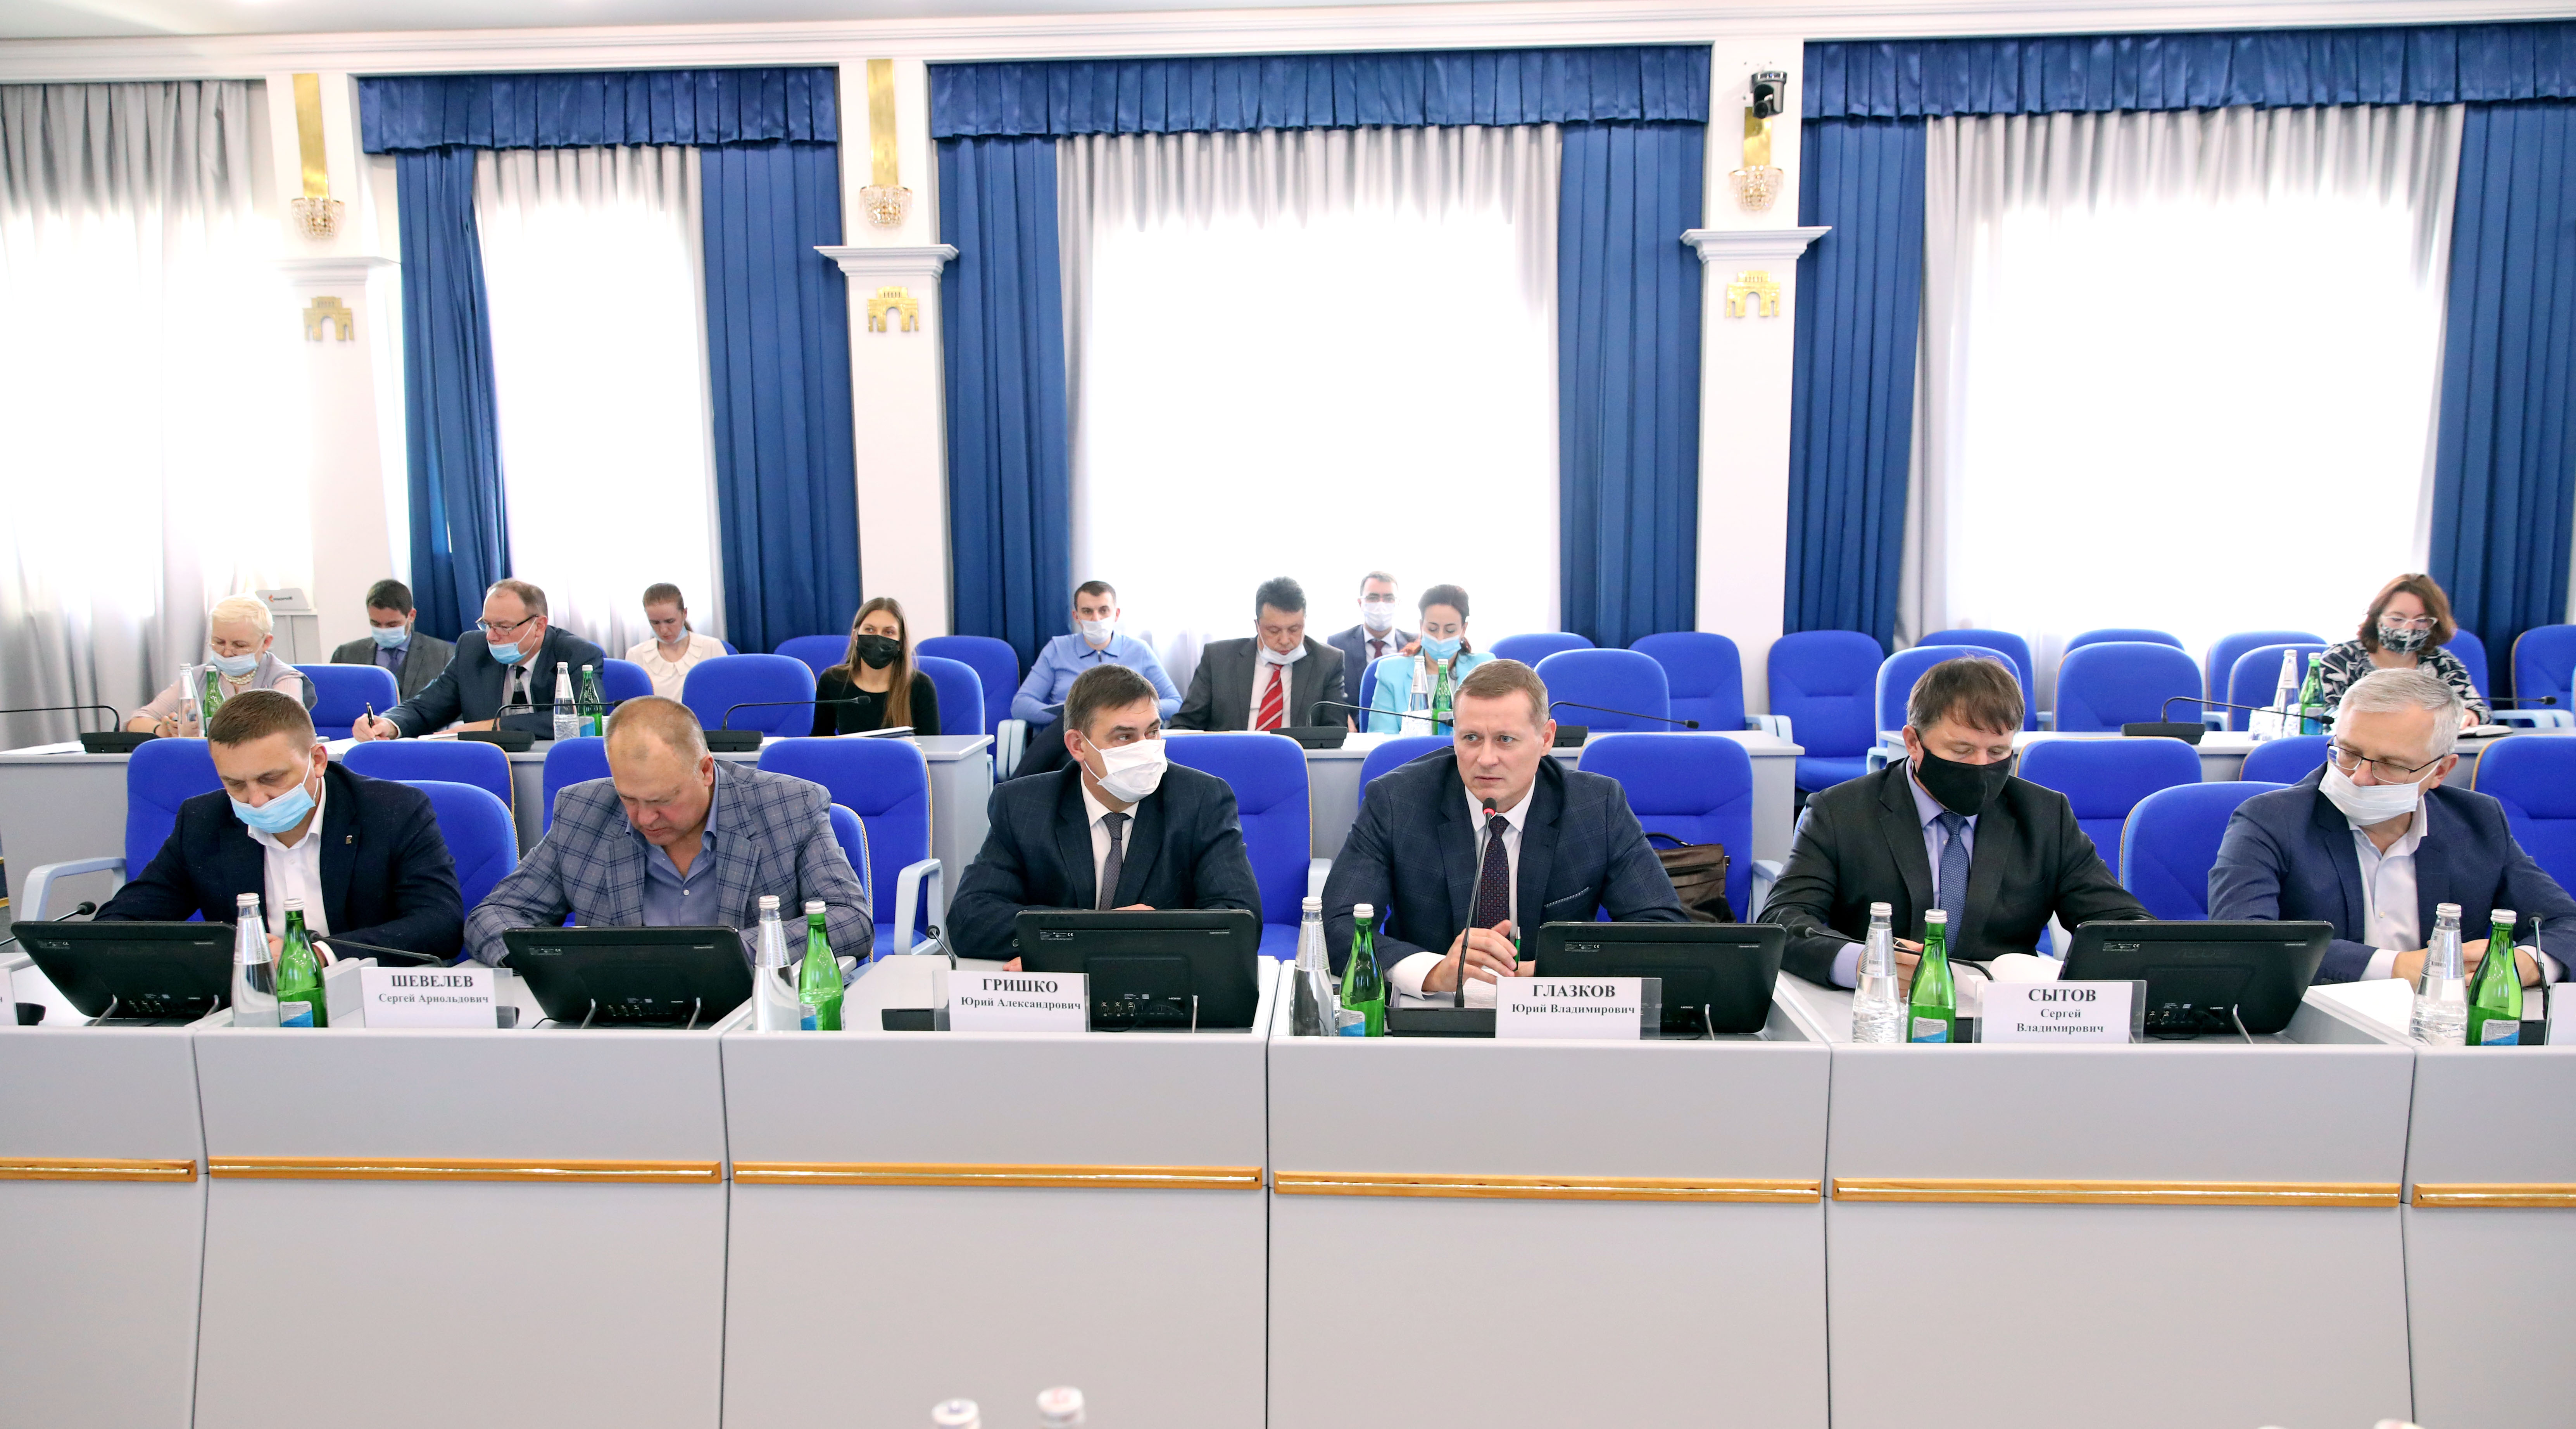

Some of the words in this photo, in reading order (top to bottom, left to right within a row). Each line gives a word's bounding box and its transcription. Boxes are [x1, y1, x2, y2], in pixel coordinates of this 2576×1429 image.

[392, 975, 473, 987] ШЕВЕЛЕВ
[983, 979, 1058, 993] ГРИШКО
[1533, 985, 1615, 997] ГЛАЗКОВ
[2028, 989, 2096, 1002] СЫТОВ
[379, 993, 415, 1004] Сергей
[419, 994, 488, 1005] Арнольдович
[961, 996, 994, 1008] Юрий
[997, 998, 1081, 1011] Александрович
[1512, 1003, 1546, 1015] Юрий
[1551, 1004, 1635, 1016] Владимирович
[2040, 1009, 2081, 1020] Сергей
[2017, 1023, 2103, 1035] Владимирович
